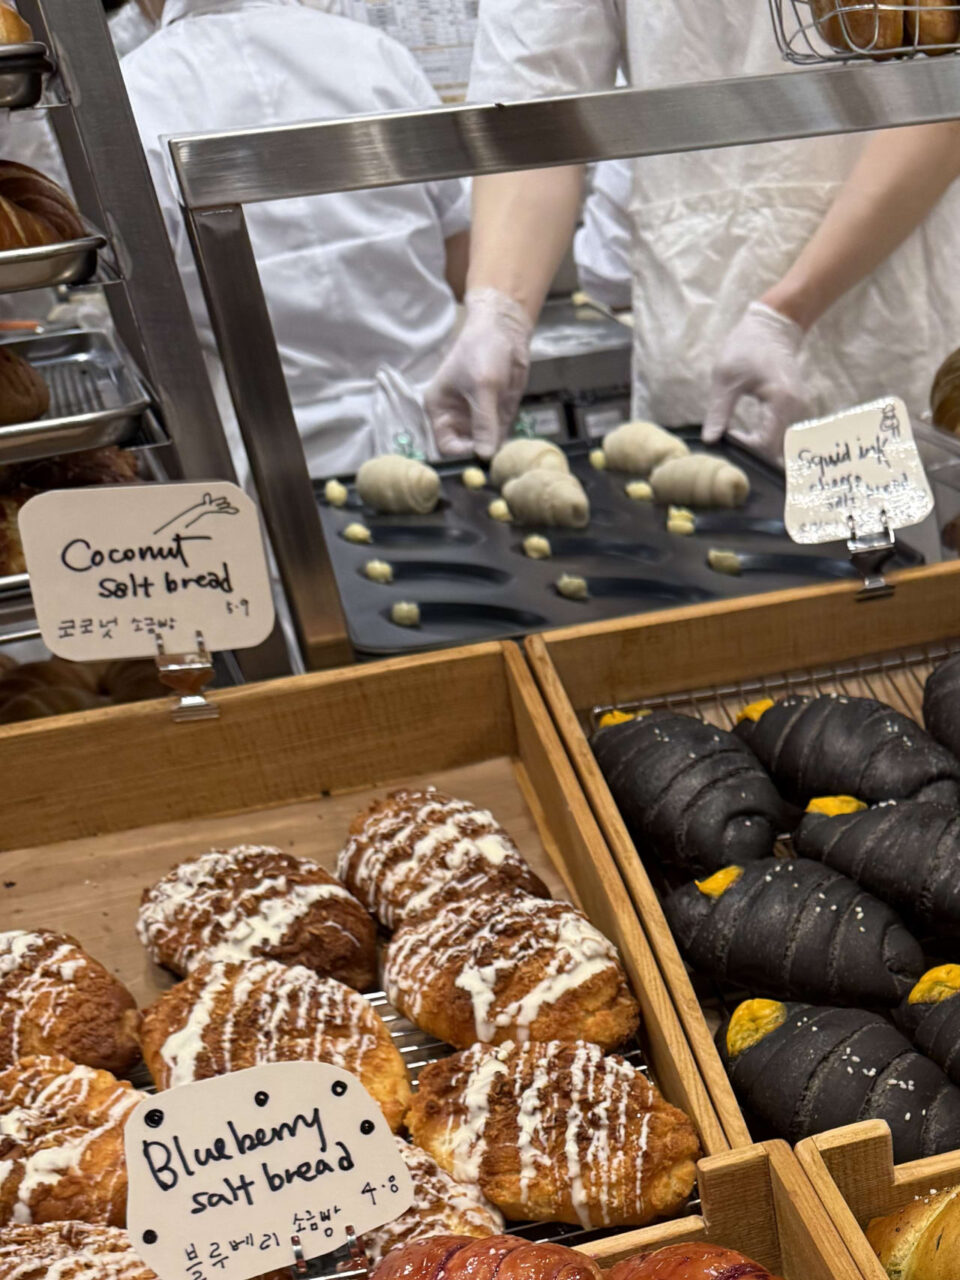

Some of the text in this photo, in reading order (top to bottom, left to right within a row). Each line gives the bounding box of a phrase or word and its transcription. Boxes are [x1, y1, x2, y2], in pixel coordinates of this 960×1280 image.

[798, 436, 891, 476] Squid ink
[61, 534, 212, 572] Coconut
[98, 562, 233, 598] salt bread
[226, 599, 249, 616] 5.9
[58, 616, 176, 639] 코코넛 소금빵
[143, 1107, 327, 1191] Blueberry
[191, 1142, 354, 1214] salt bread
[361, 1175, 399, 1205] 4.8
[293, 1205, 342, 1237] 소금빵
